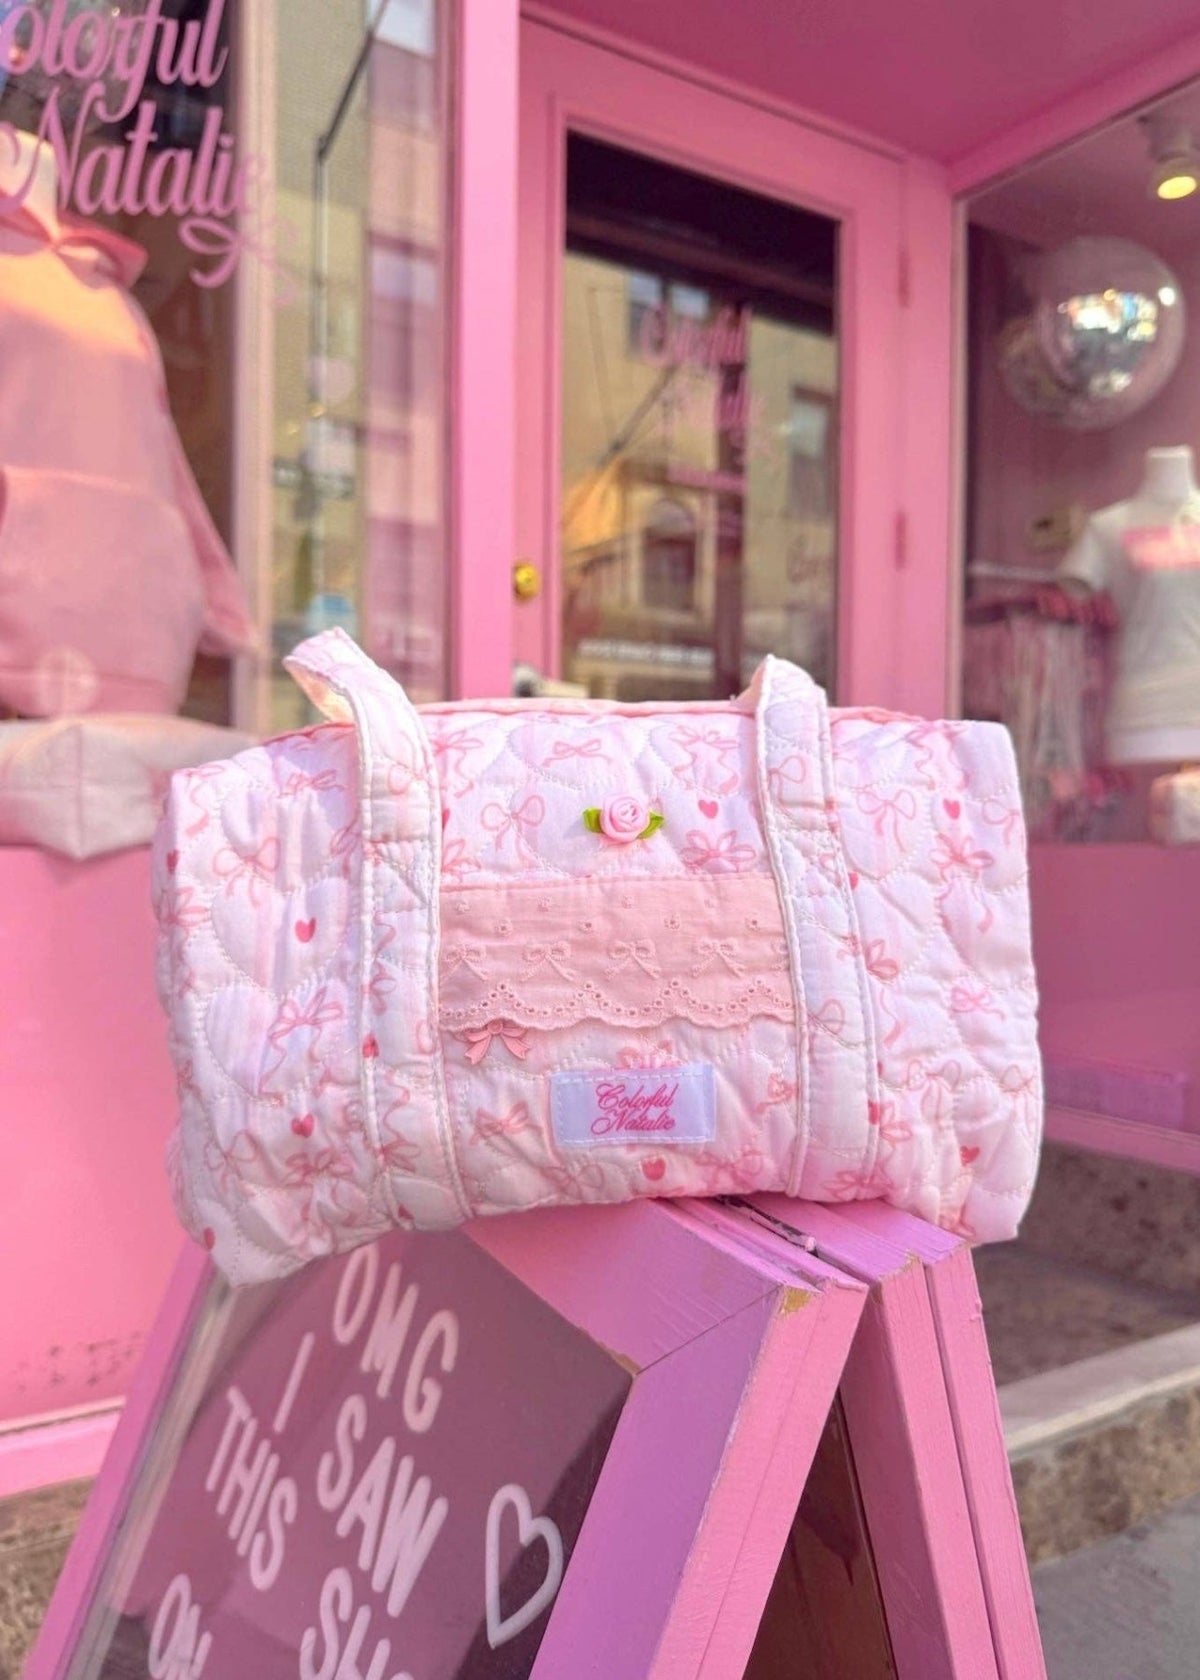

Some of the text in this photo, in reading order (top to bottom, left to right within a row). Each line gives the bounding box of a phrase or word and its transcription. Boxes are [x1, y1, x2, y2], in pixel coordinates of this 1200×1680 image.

[0, 0, 229, 123] olorful
[590, 1109, 677, 1135] Natalie
[595, 1083, 679, 1116] Colorful
[333, 1245, 459, 1433] OMG
[206, 1386, 415, 1680] THIS SH
[273, 1332, 449, 1618] I SAW
